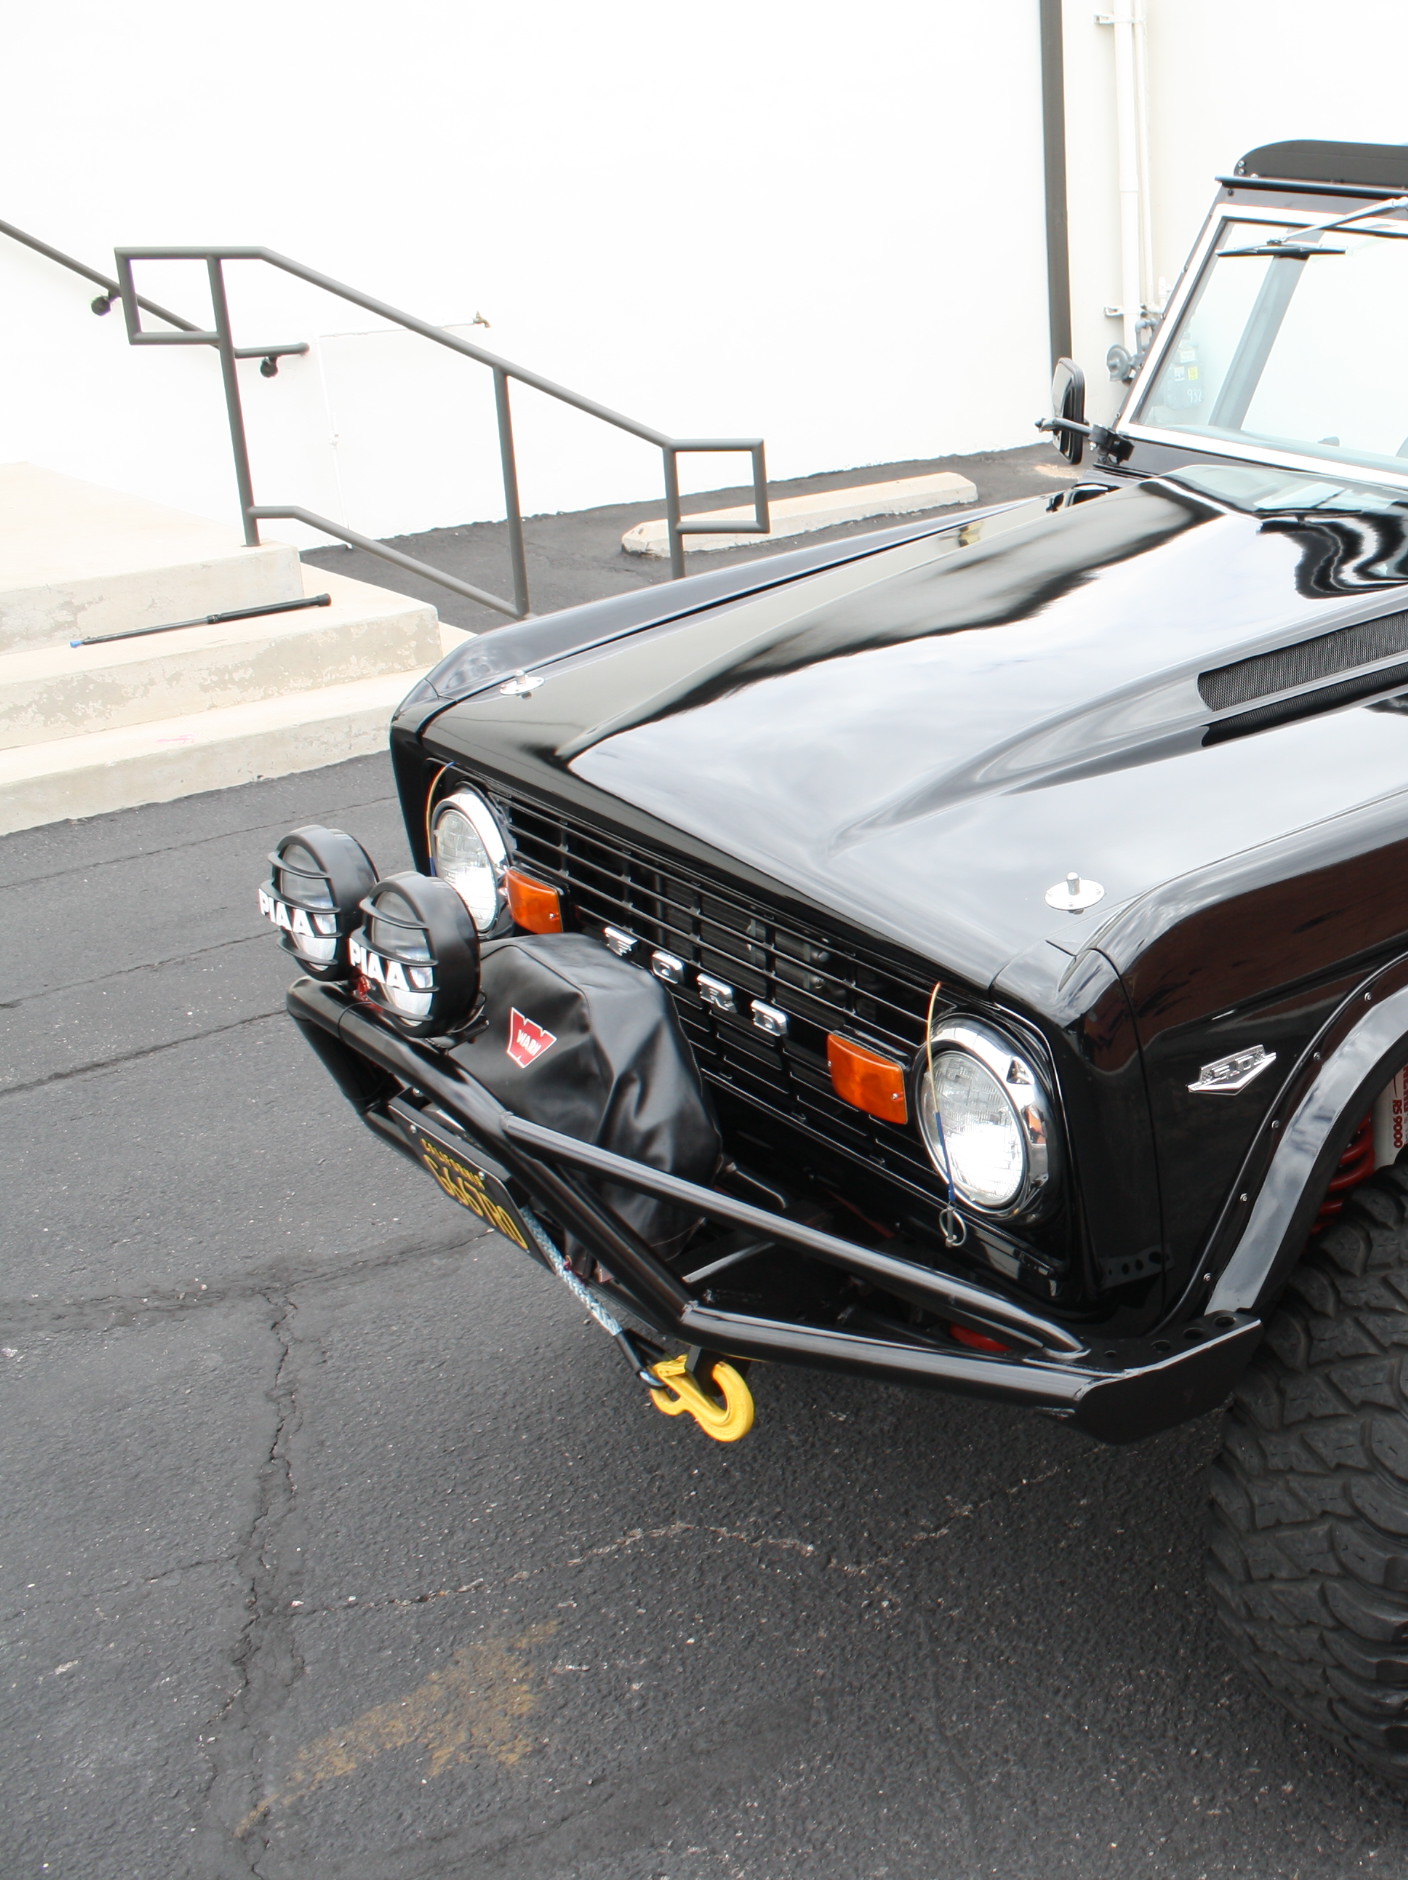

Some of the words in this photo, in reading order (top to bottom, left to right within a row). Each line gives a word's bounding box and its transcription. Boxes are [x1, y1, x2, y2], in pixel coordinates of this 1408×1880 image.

[258, 887, 315, 938] PIAA
[349, 936, 411, 992] PIAA
[603, 926, 789, 1037] FORD
[516, 1028, 542, 1057] WARN
